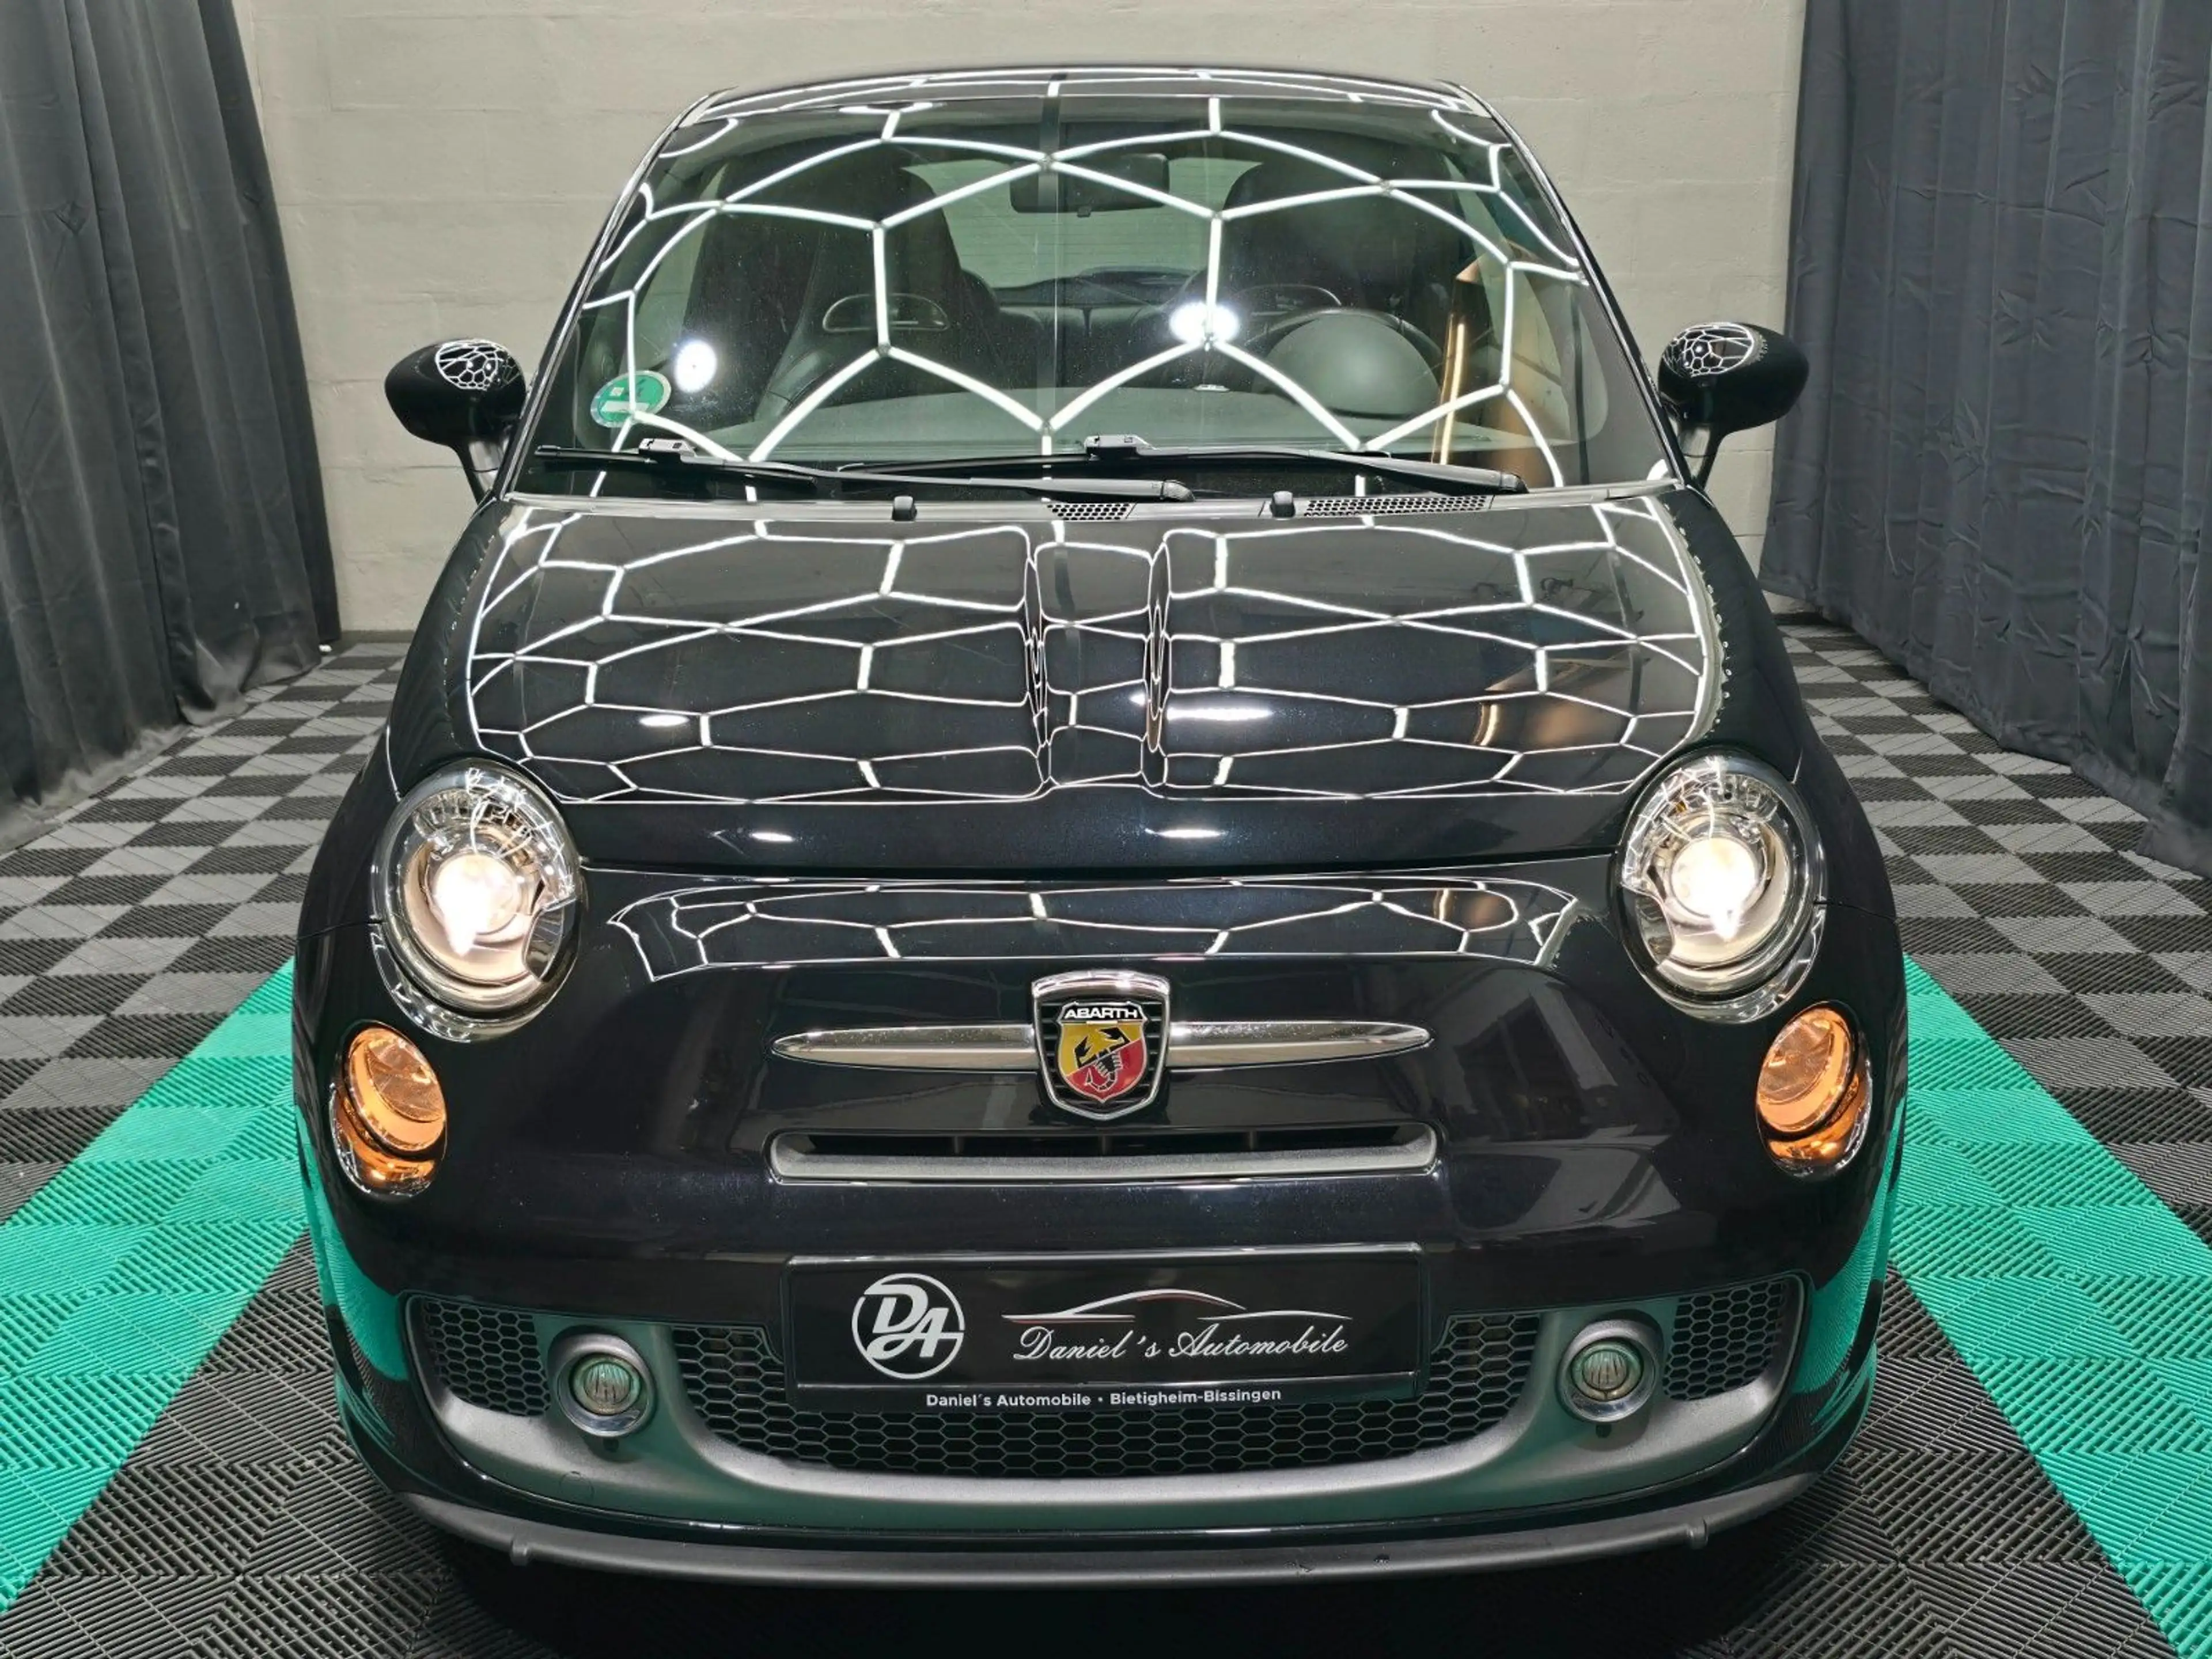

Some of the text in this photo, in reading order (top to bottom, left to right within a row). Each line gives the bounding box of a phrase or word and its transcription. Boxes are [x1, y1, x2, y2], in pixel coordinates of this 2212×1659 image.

[1065, 1007, 1138, 1018] ABARTH
[1168, 1323, 1348, 1357] Automobile
[997, 1393, 1092, 1406] Automobile
[1109, 1389, 1281, 1406] Bietigheim-Bissingen
